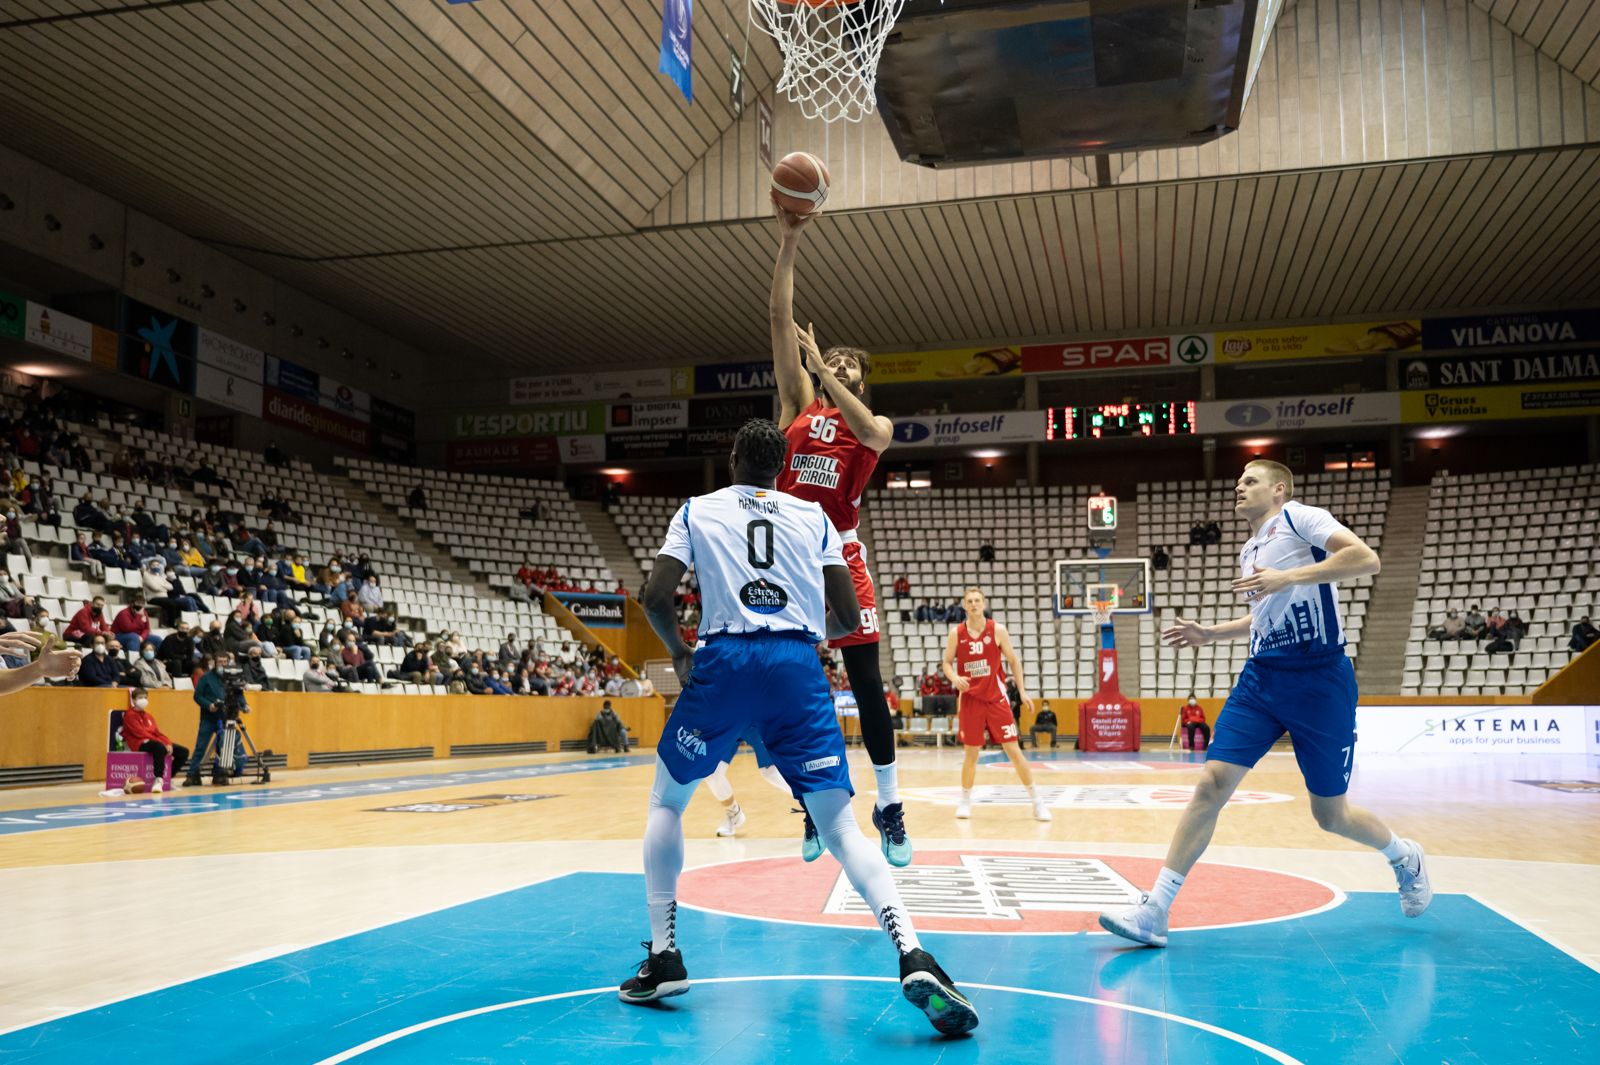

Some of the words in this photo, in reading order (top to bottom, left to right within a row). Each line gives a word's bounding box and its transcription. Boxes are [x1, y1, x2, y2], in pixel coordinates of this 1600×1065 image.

[1451, 321, 1577, 346] VILANOVA
[1062, 342, 1168, 366] SPAR
[1440, 360, 1503, 385] SANT
[647, 402, 682, 411] DIGITAL
[1276, 396, 1356, 418] infoself
[1440, 395, 1476, 405] Grues
[268, 395, 366, 445] diaridegirona.cat
[455, 410, 588, 436] L'ESPORTIU
[935, 415, 1005, 435] infoself
[1276, 418, 1306, 429] group
[808, 415, 839, 443] 96
[934, 435, 960, 446] group
[455, 445, 520, 458] BAUHAUS
[792, 455, 834, 473] ORGULL
[738, 496, 780, 514] HAMILTON
[747, 519, 775, 570] 0
[748, 596, 780, 606] Galicia
[571, 603, 623, 618] CaixaBank
[968, 641, 984, 655] 30
[1002, 723, 1018, 739] 30
[1425, 719, 1561, 732] SIXTEMIA
[1449, 737, 1474, 745] apps
[1475, 736, 1489, 744] for
[1491, 737, 1513, 745] your
[1517, 736, 1561, 744] business
[111, 764, 139, 772] FINQUES
